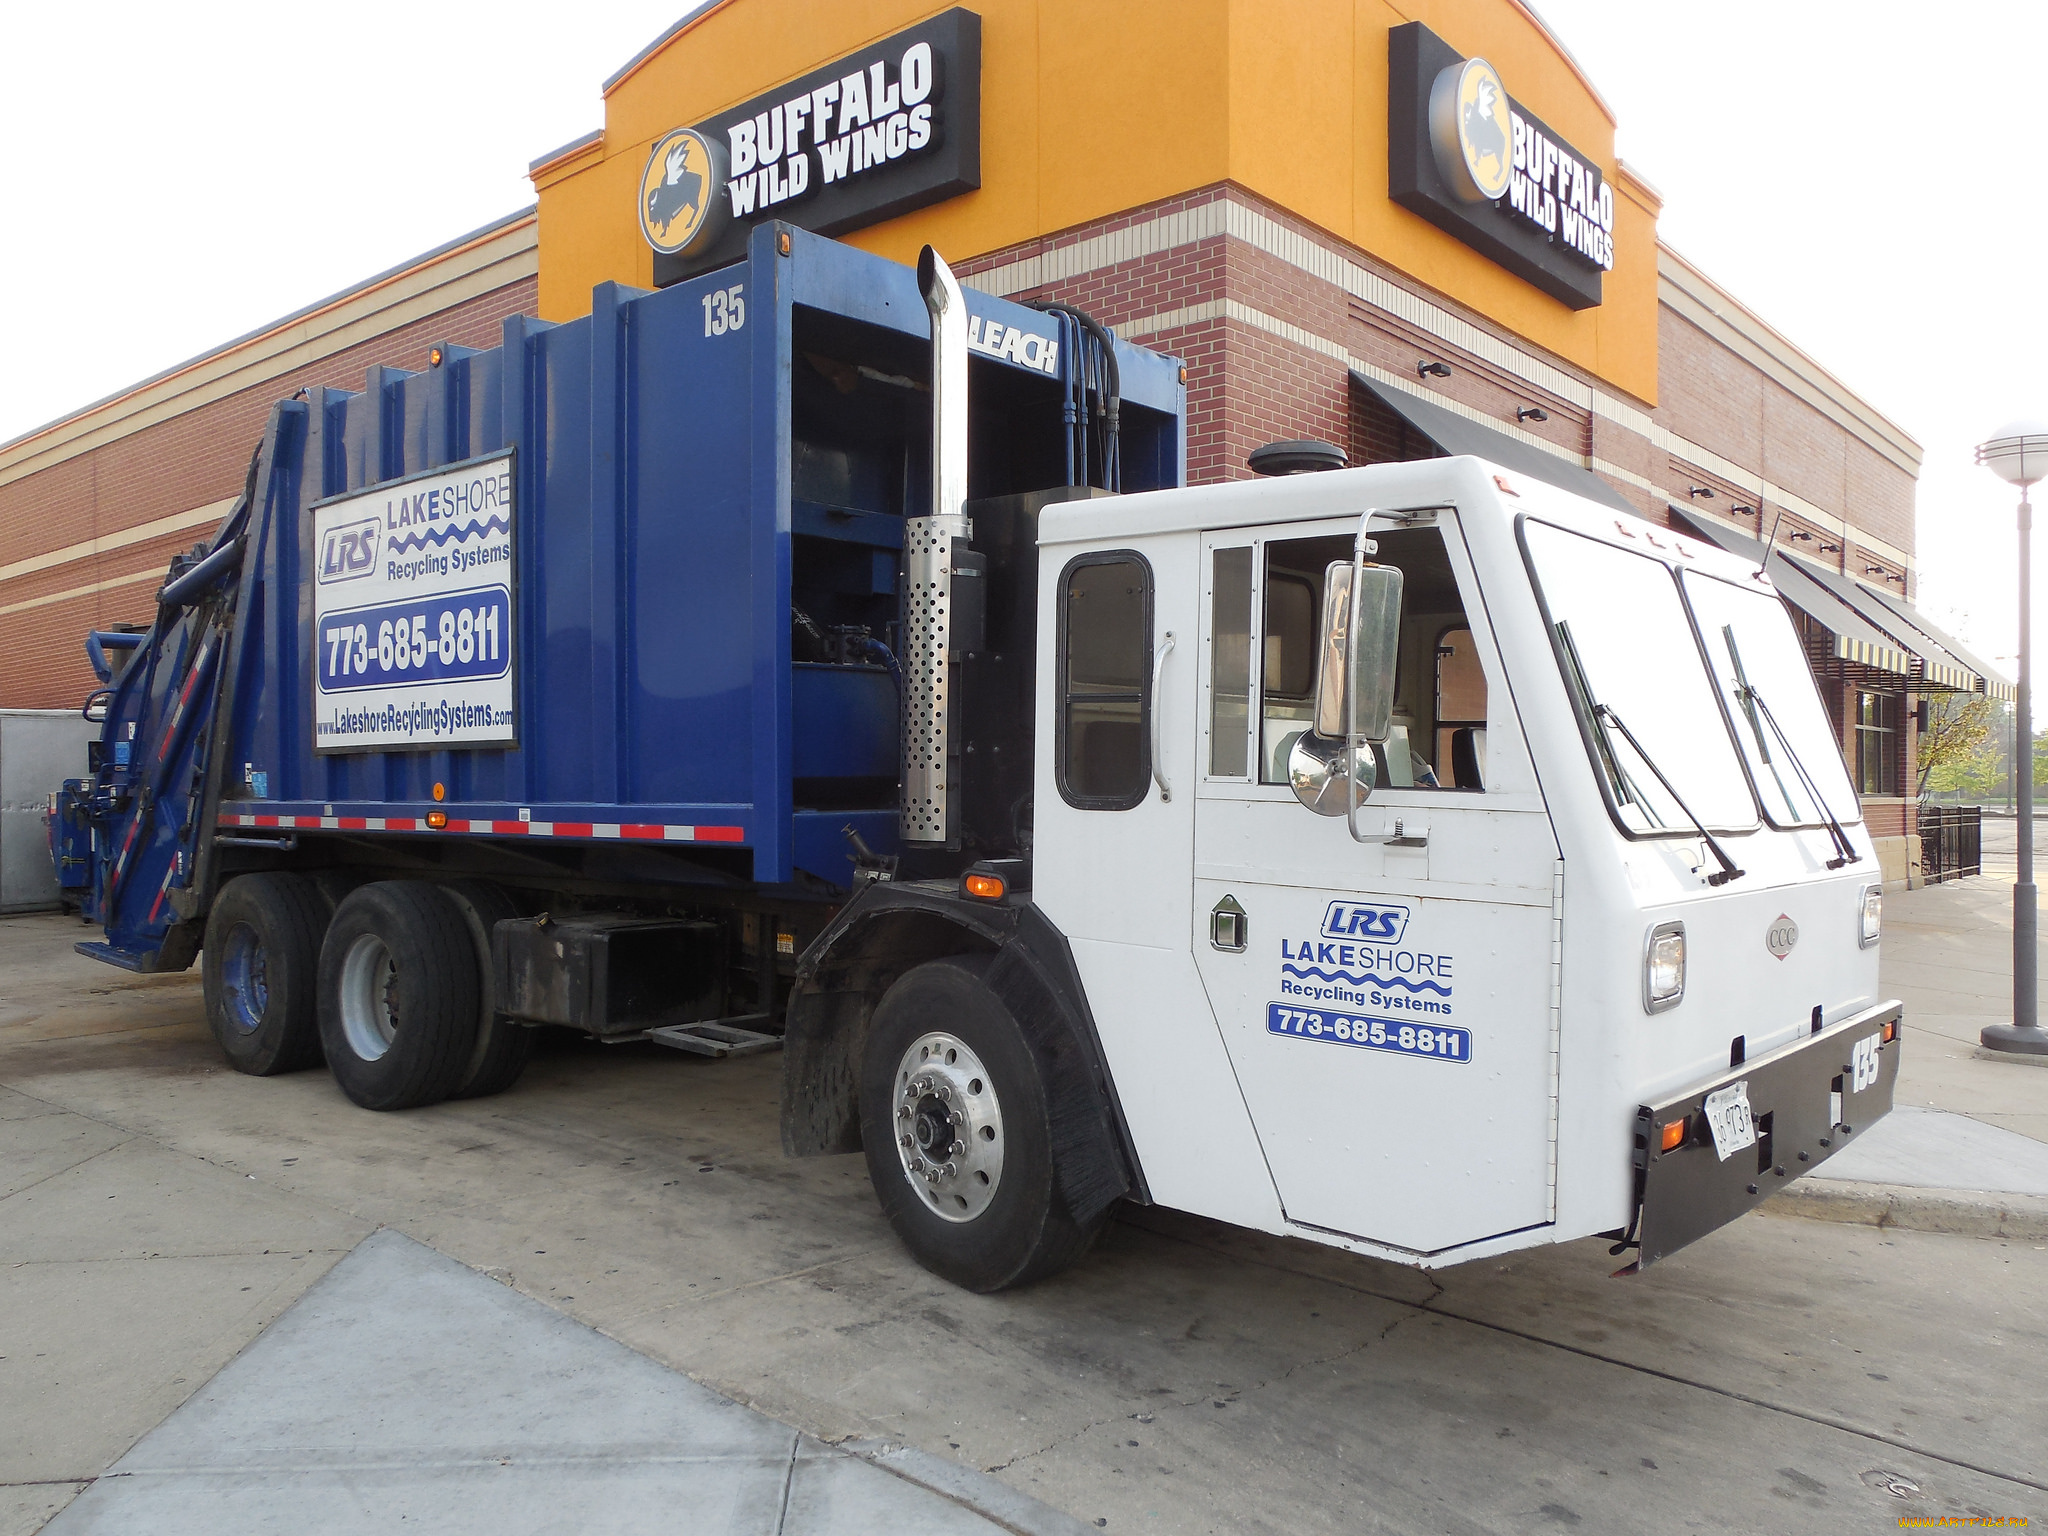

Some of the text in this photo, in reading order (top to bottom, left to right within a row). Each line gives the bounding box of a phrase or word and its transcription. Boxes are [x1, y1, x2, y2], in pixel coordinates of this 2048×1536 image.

[728, 42, 932, 178] BUFFALO
[728, 104, 932, 218] WILD WINGS
[1510, 111, 1614, 233] BUFFALO
[1509, 168, 1614, 271] WILD WINGS
[702, 284, 745, 338] 135
[968, 315, 1058, 374] LEACH
[387, 473, 510, 530] LAKESHORE
[323, 527, 374, 577] LRS
[387, 544, 510, 581] Recycling Systems
[326, 605, 499, 677] 773-685-8811
[317, 700, 513, 736] www.LakeshoreRecyclingSystems.com
[1328, 906, 1400, 938] LRS
[1770, 927, 1795, 948] CCC
[1281, 939, 1453, 978] LAKESHORE
[1281, 979, 1452, 1014] Recycling Systems
[1277, 1009, 1460, 1056] 773-685-8811
[1853, 1032, 1880, 1094] 135
